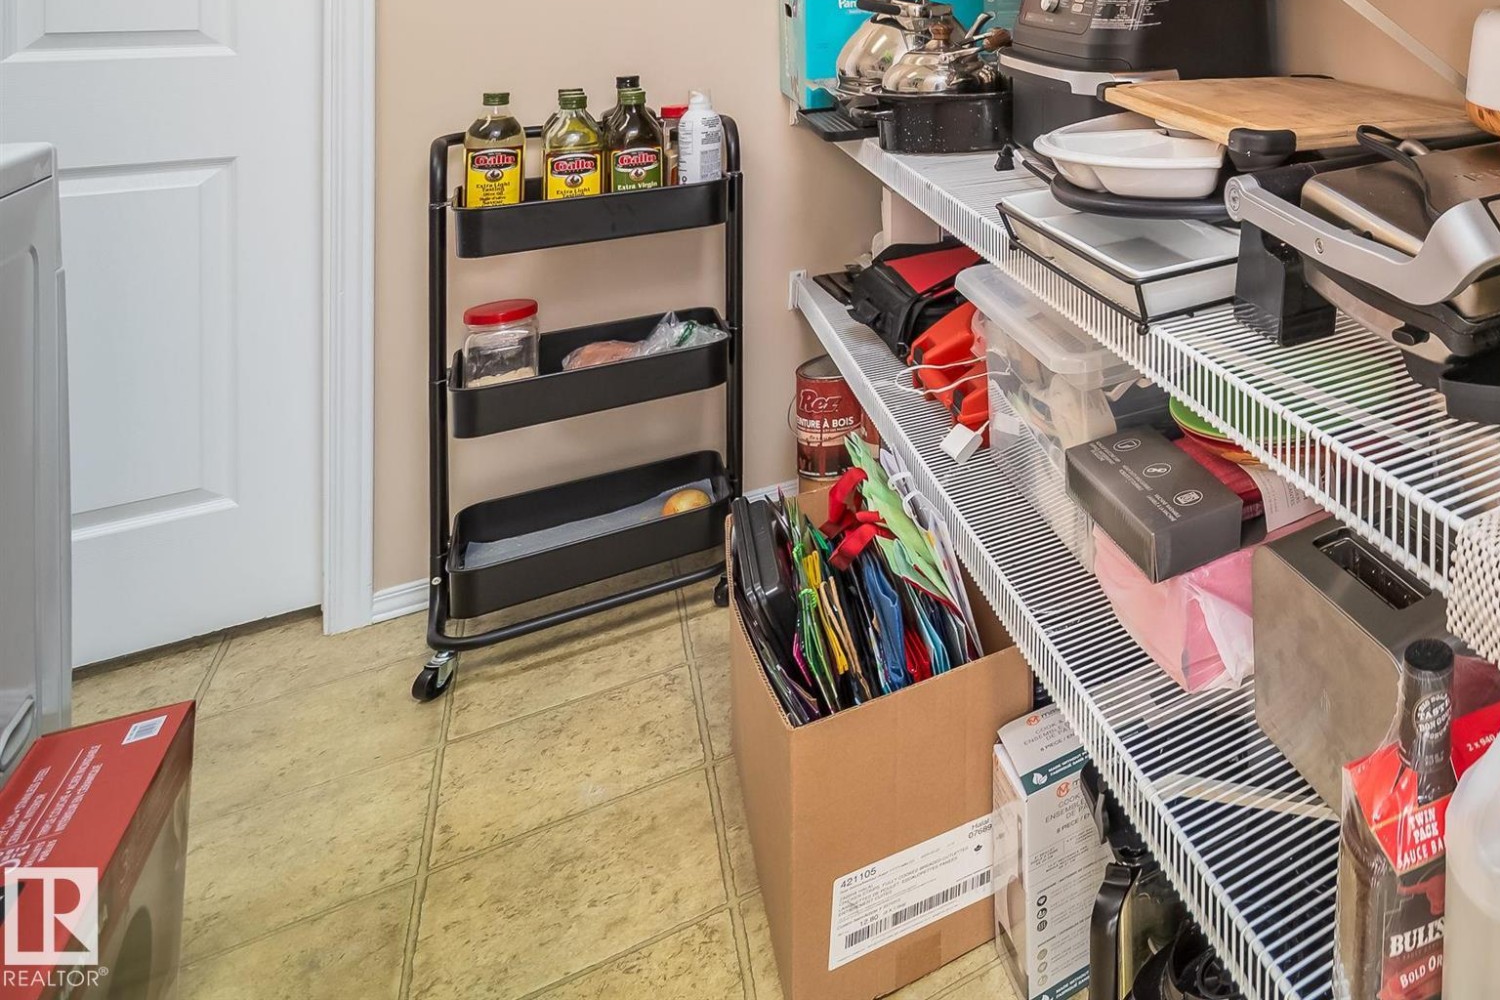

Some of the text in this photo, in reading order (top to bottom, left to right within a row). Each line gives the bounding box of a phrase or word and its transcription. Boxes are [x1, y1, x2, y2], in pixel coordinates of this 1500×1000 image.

[474, 154, 516, 167] Gallo
[554, 159, 595, 173] Gallo
[619, 152, 657, 165] Gallo
[822, 417, 830, 429] À
[832, 416, 854, 428] BOIS
[1466, 742, 1474, 752] 2
[1409, 807, 1436, 830] TWIN
[968, 824, 992, 839] 07689
[1413, 821, 1439, 845] PACK
[1397, 842, 1429, 869] SAUCE
[840, 866, 877, 889] 421105
[1400, 964, 1426, 989] BOLD
